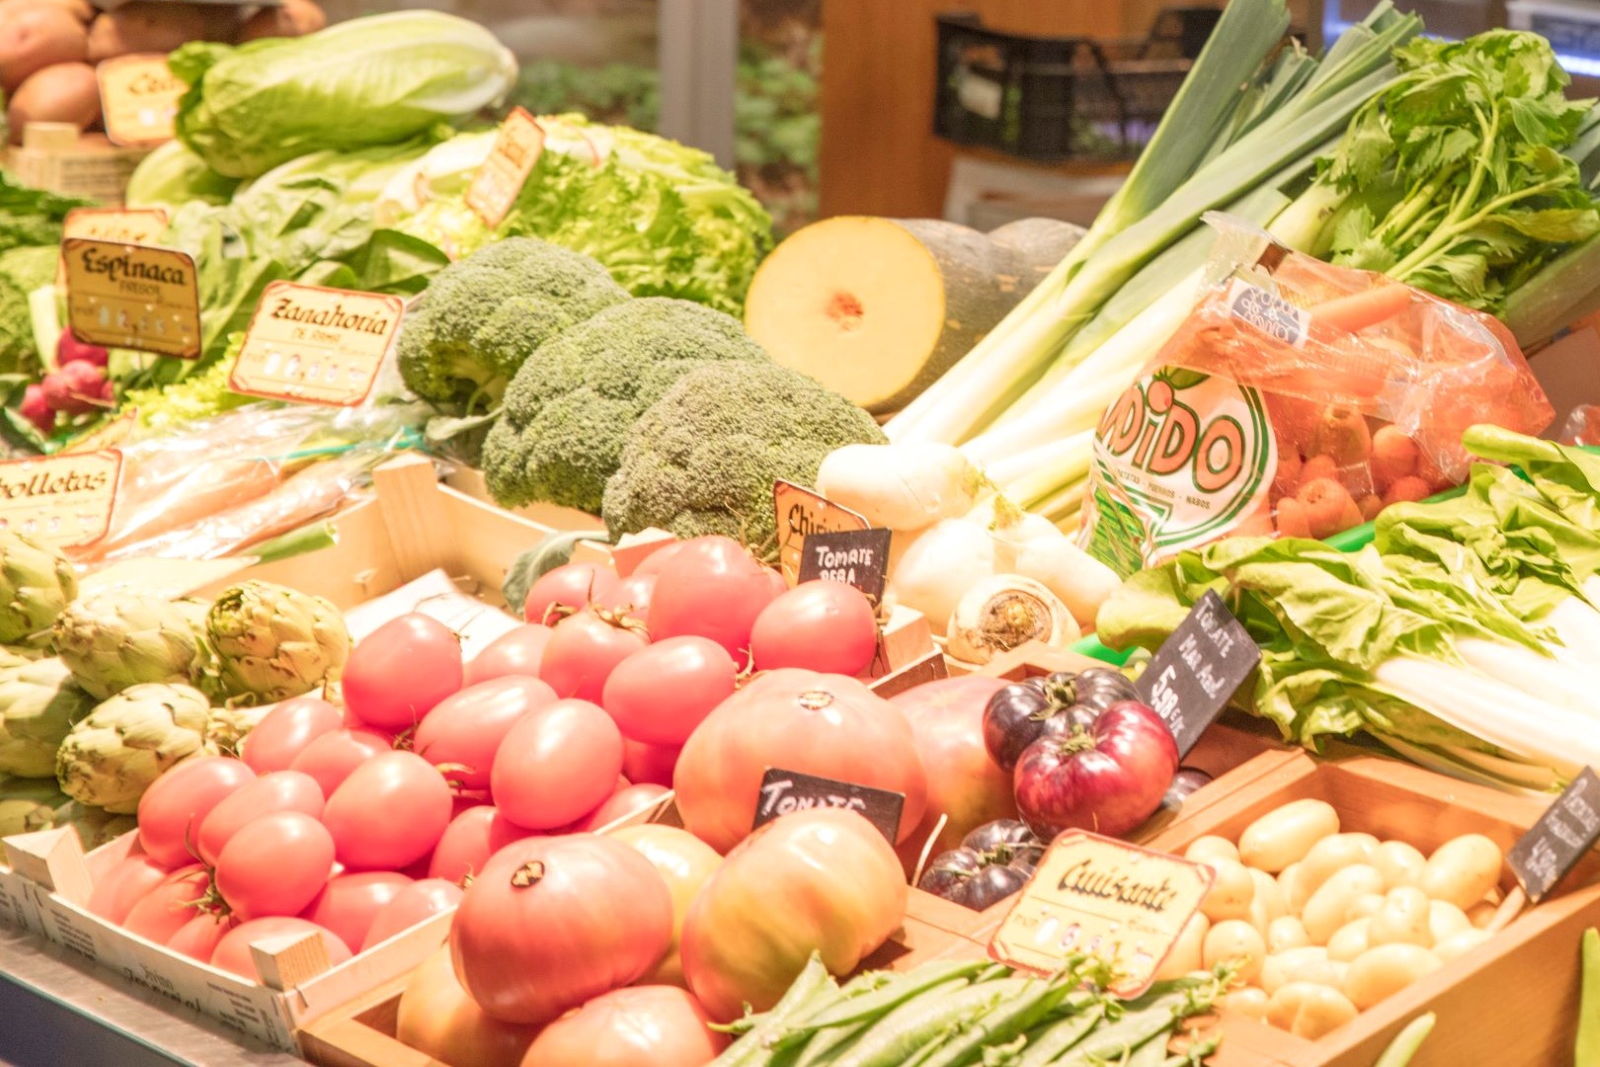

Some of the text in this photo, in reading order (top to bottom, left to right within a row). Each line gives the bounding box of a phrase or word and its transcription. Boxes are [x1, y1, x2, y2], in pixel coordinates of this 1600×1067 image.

[81, 247, 185, 286] Espinaca
[271, 297, 388, 335] Zanahoria
[1185, 494, 1211, 510] NABOS
[816, 545, 874, 569] TOMATE
